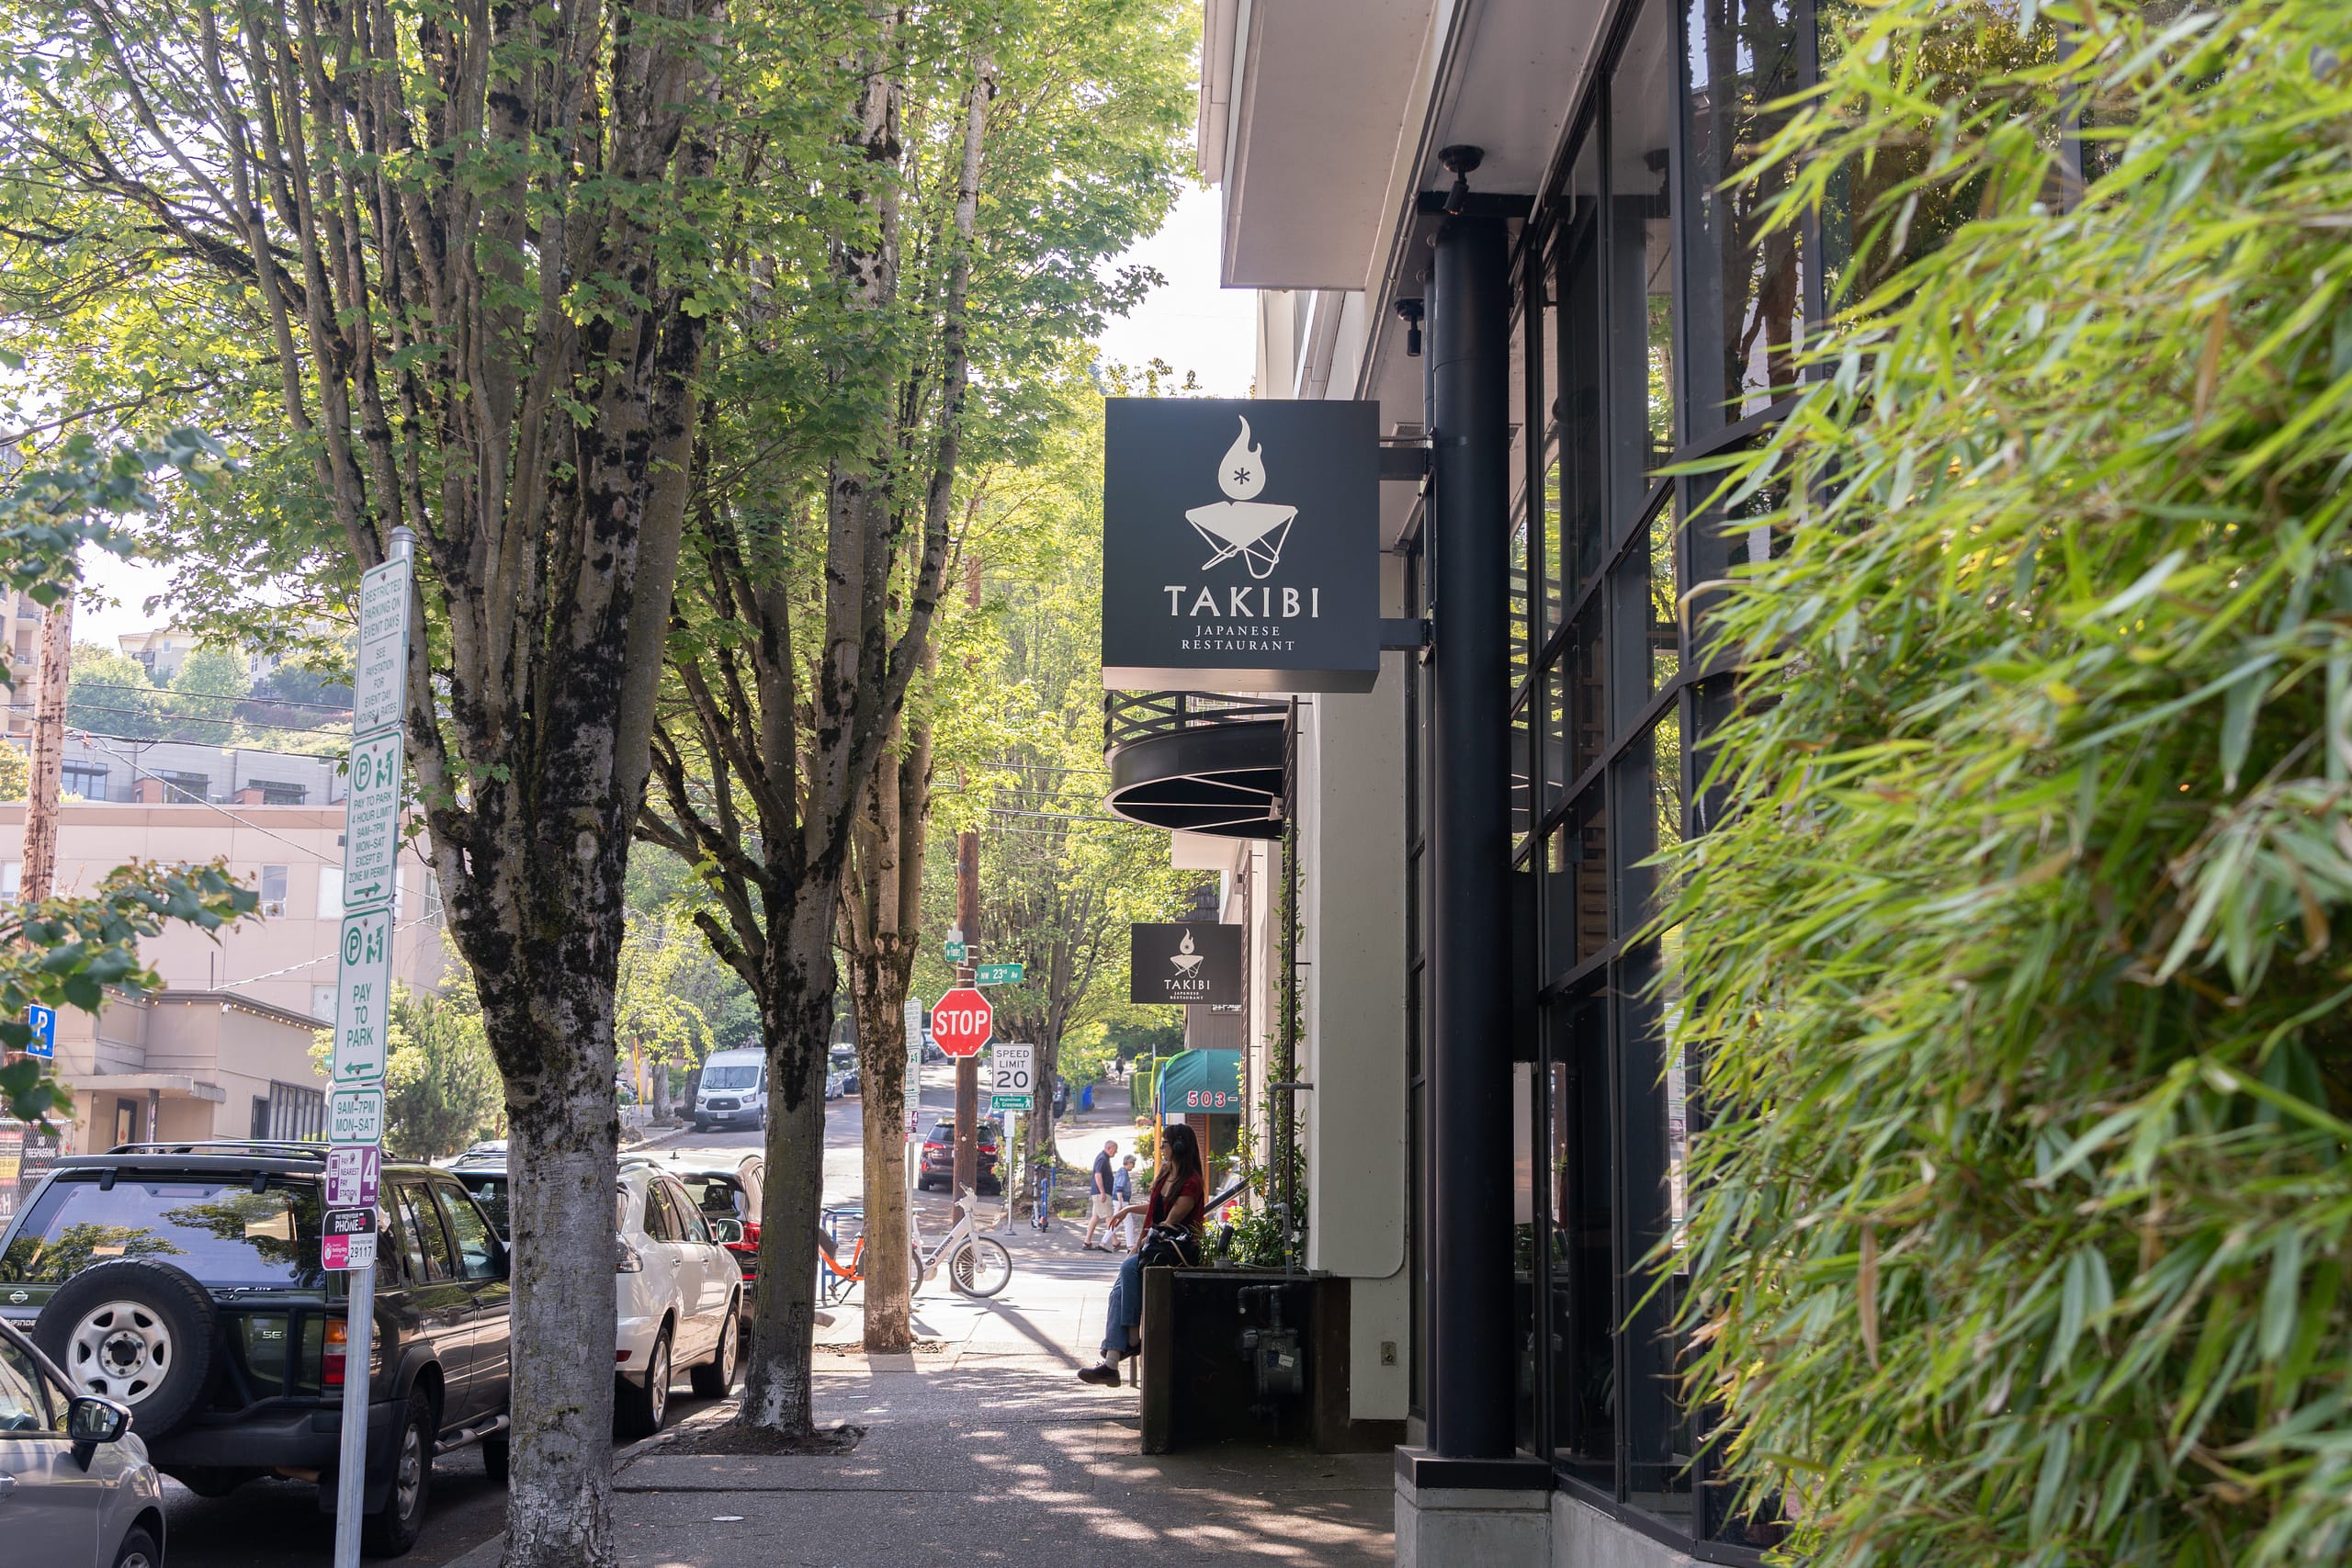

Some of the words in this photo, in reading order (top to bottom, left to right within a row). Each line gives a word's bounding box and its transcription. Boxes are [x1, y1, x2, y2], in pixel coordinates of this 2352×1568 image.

[365, 578, 401, 603] RESTRICTED
[364, 600, 390, 621] PARKING
[391, 595, 401, 610] ON
[1163, 585, 1318, 617] TAKIBI
[364, 620, 383, 638] EVENT
[385, 614, 400, 630] DAYS
[1195, 625, 1280, 637] JAPANESE
[1182, 639, 1295, 650] RESTAURANT
[376, 647, 386, 660] SEE
[374, 676, 384, 690] FOR
[365, 693, 381, 707] EVENT
[381, 690, 391, 701] DAY
[357, 709, 376, 725] HOURS
[381, 702, 397, 715] RATES
[354, 799, 364, 809] PAY
[367, 795, 374, 807] TO
[376, 791, 392, 805] PARK
[352, 815, 356, 824] 4
[356, 809, 375, 824] HOUR
[376, 805, 393, 818] LIMIT
[356, 837, 386, 852] MON-SAT
[356, 853, 376, 867] EXCEPT
[376, 851, 384, 863] BY
[348, 870, 363, 883] ZONE
[370, 864, 390, 879] PERMIT
[980, 971, 989, 979] NW
[993, 968, 1008, 979] 23rd
[1164, 979, 1210, 990] TAKIBI
[353, 982, 372, 1003] PAY
[354, 1006, 368, 1025] TO
[935, 1010, 988, 1036] STOP
[346, 1026, 374, 1048] PARK
[996, 1050, 1029, 1058] SPEED
[999, 1060, 1025, 1068] LIMIT
[996, 1070, 1028, 1089] 20
[1187, 1090, 1238, 1108] 503-
[337, 1100, 376, 1114] 9AM-7PM
[335, 1118, 376, 1132] MON-SAT
[912, 1112, 918, 1123] 4
[341, 1168, 360, 1176] NEAREST
[363, 1151, 378, 1190] 4
[340, 1179, 348, 1187] PAY
[339, 1189, 357, 1198] STATION
[334, 1219, 359, 1232] PHONE
[350, 1246, 372, 1258] 29117
[262, 1330, 282, 1339] SE
